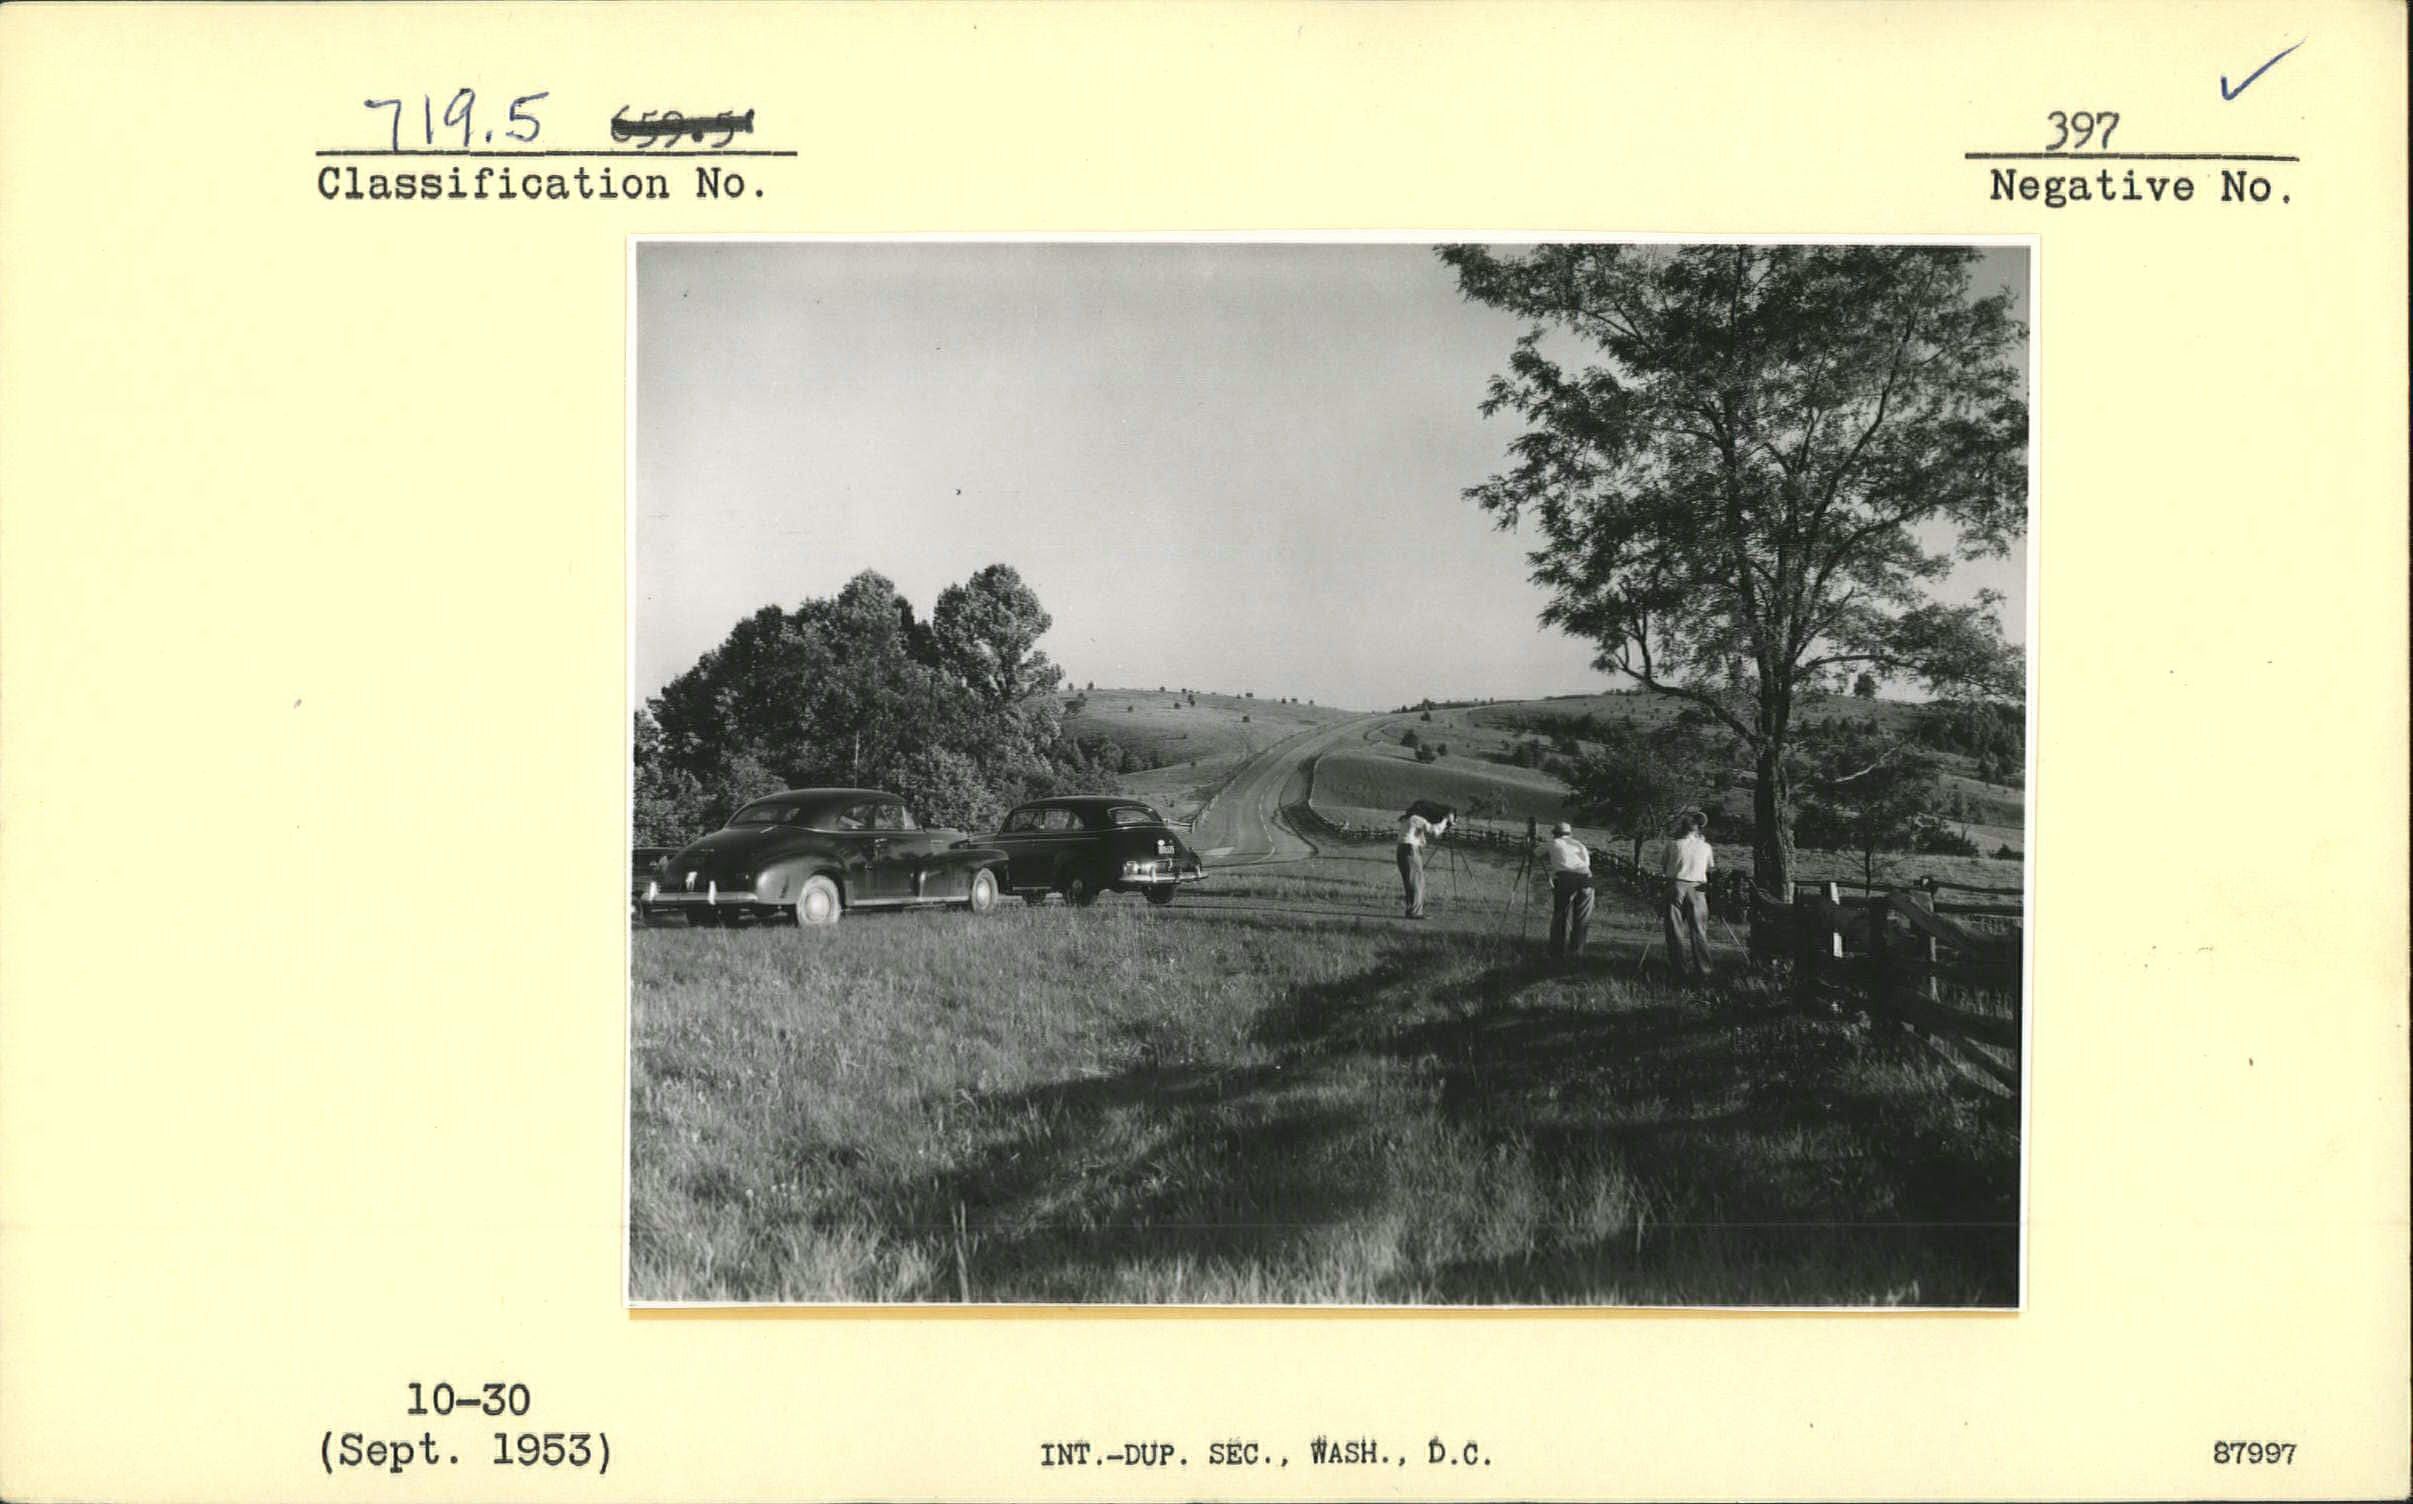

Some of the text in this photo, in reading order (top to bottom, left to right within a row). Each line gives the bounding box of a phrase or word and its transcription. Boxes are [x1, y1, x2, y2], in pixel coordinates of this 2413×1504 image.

[363, 88, 550, 151] 719.5
[2045, 110, 2120, 151] 397
[317, 166, 764, 200] Classification No.
[1989, 168, 2291, 208] Negative No.
[407, 1382, 531, 1417] 10-30
[321, 1431, 612, 1475] (Sept. 1953)
[1040, 1436, 1492, 1468] INT.-DUP. SEC., WASH., D.C.
[2213, 1440, 2297, 1466] 87997
